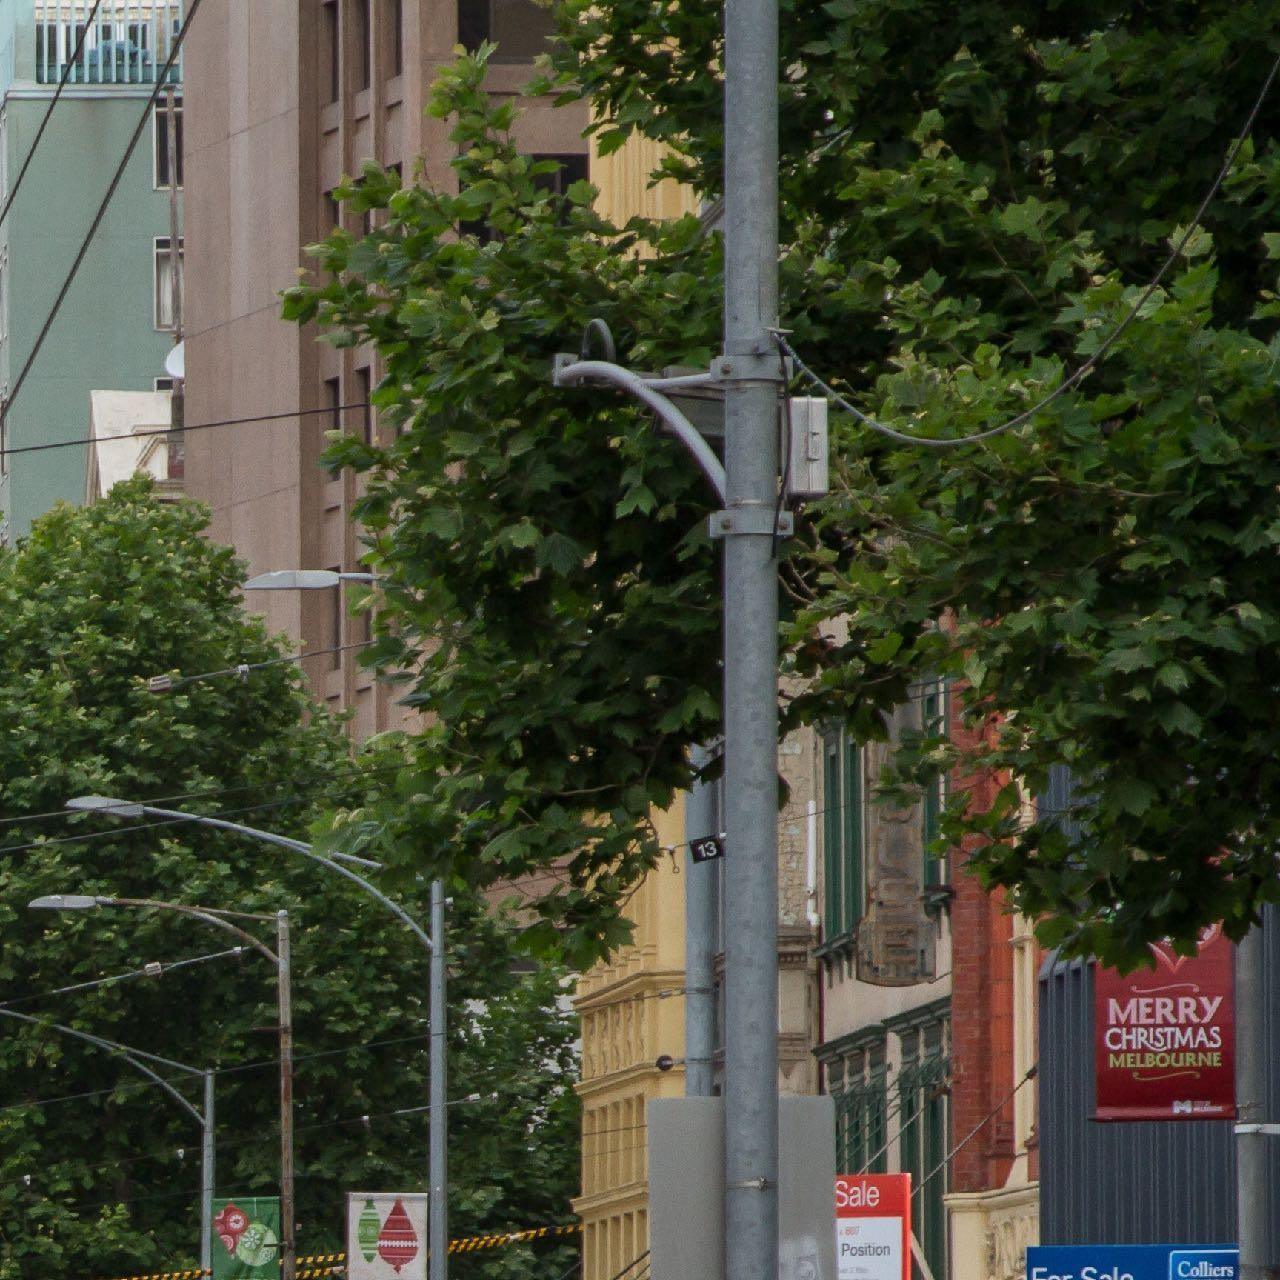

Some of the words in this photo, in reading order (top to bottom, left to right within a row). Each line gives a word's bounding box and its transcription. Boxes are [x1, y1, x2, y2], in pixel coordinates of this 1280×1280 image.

[699, 841, 718, 858] 13
[1108, 996, 1223, 1025] MERRY
[1105, 1026, 1222, 1051] CHRISTMAS
[1109, 1052, 1222, 1068] MELBOURNE
[834, 1180, 880, 1207] Sale
[841, 1243, 891, 1257] Position
[1177, 1260, 1234, 1278] Colliers
